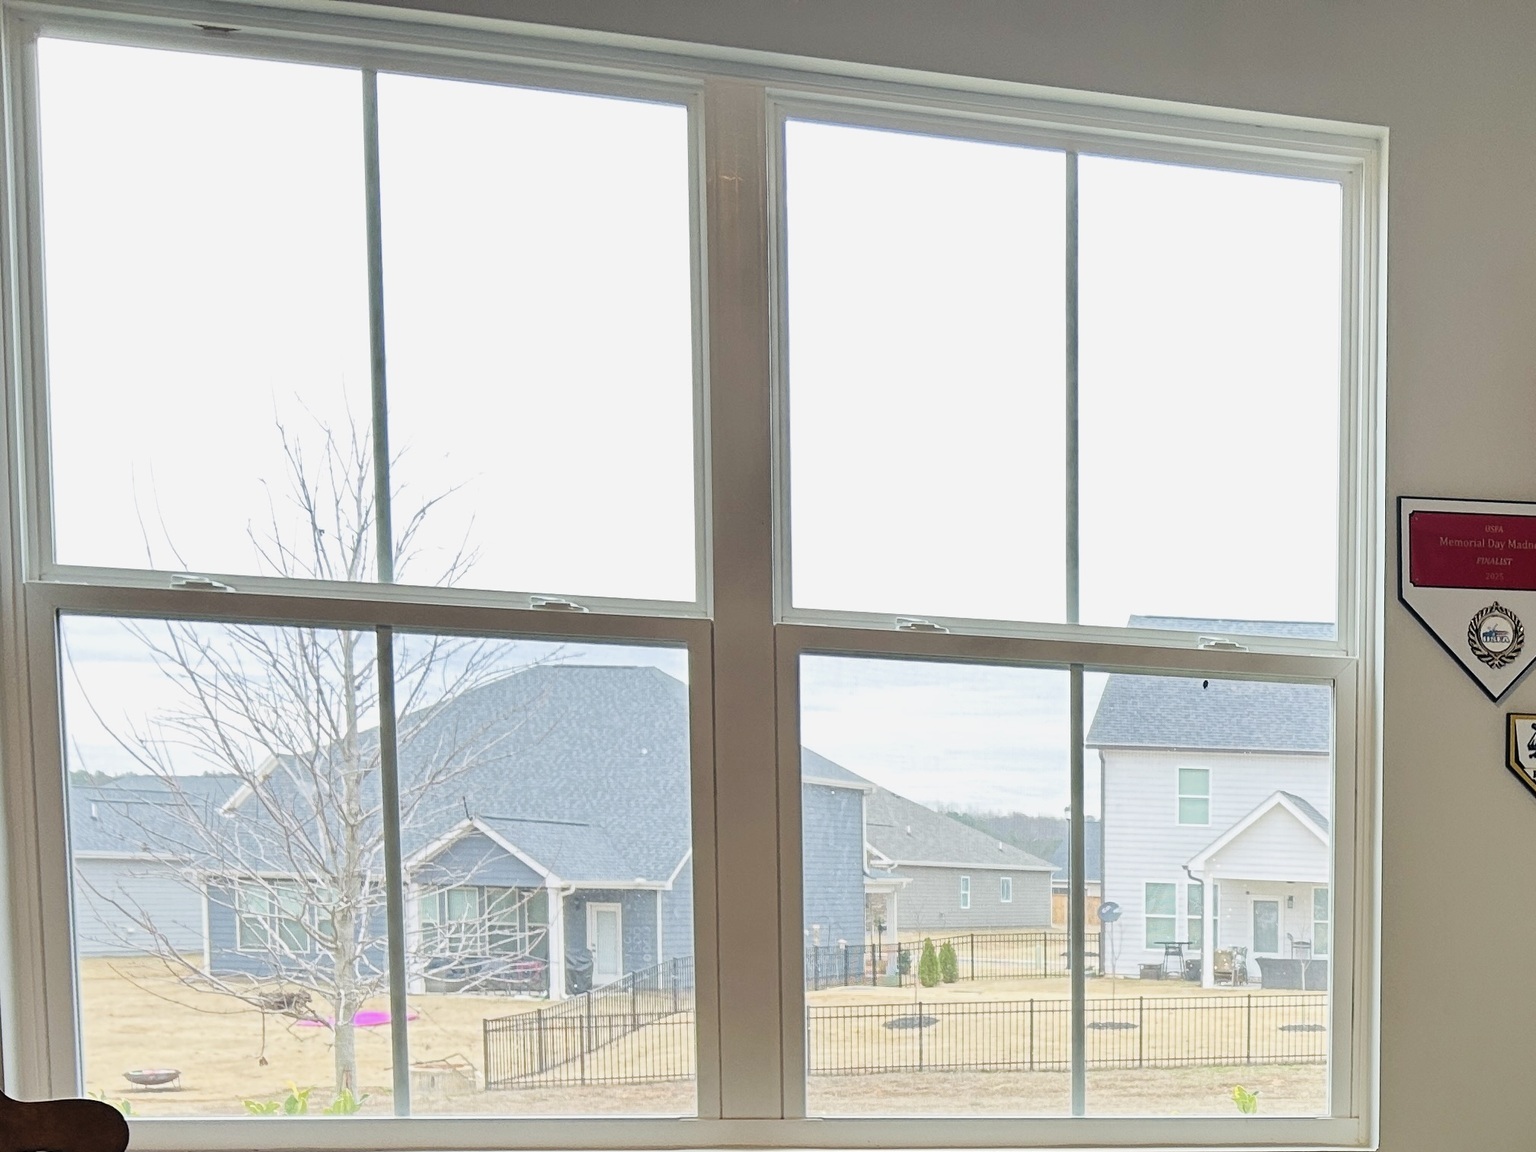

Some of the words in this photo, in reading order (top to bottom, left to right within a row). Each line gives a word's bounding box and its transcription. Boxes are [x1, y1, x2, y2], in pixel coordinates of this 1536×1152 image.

[1440, 536, 1485, 548] Memorial
[1487, 538, 1506, 550] Day
[1476, 557, 1513, 566] FINALIST
